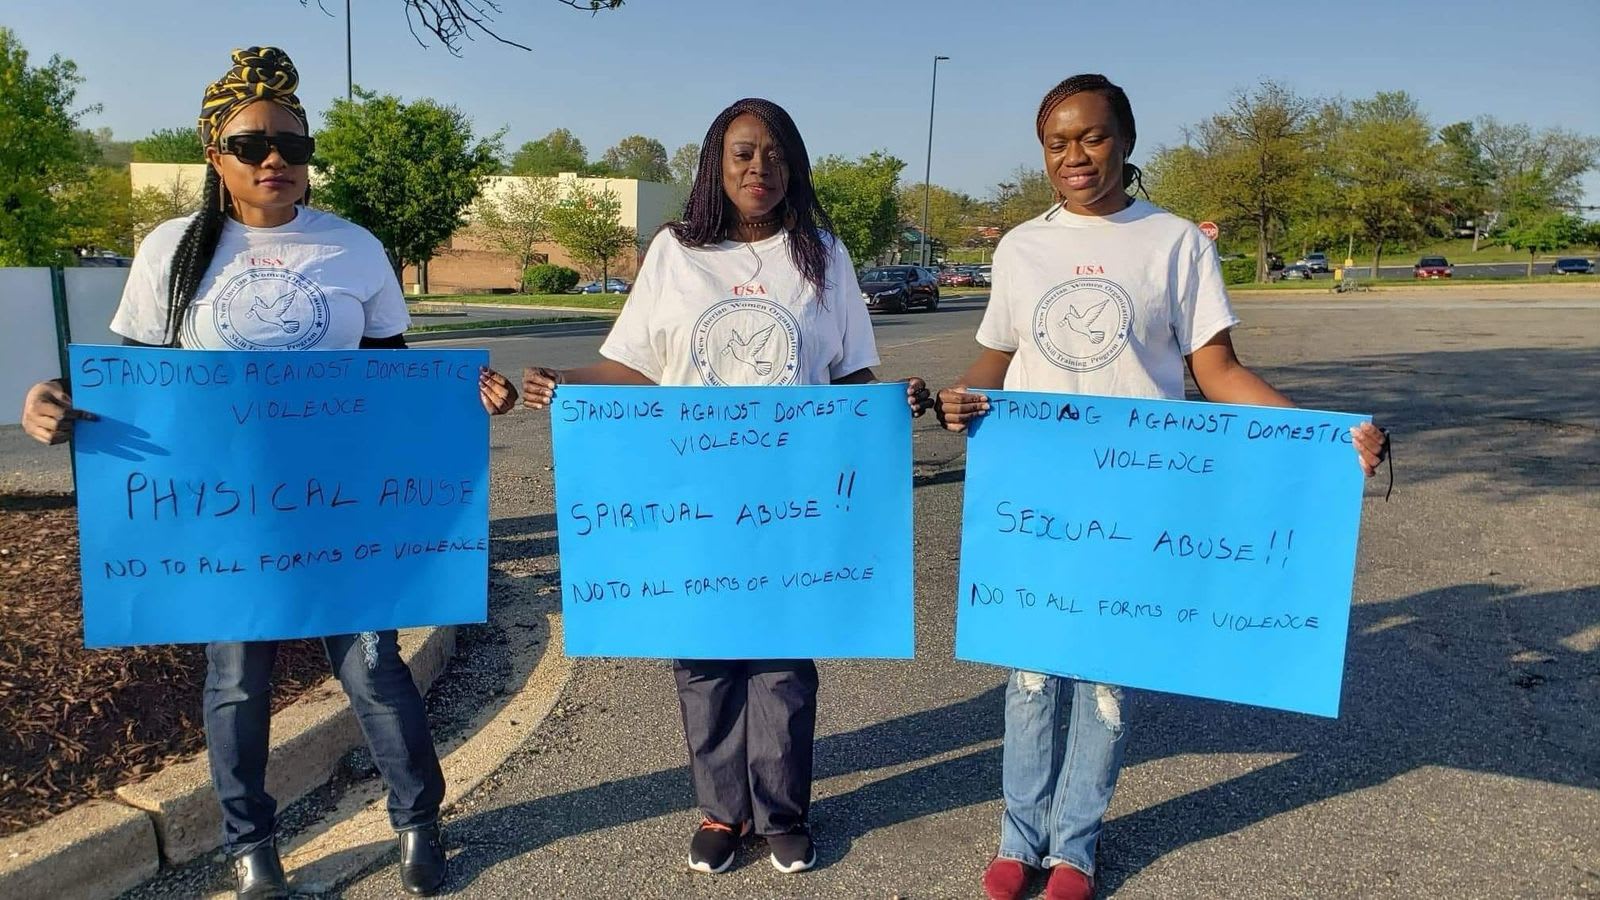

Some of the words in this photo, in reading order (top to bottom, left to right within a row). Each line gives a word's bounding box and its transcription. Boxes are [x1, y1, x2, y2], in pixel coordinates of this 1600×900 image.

[251, 258, 284, 266] USA
[1076, 265, 1105, 275] USA
[220, 303, 229, 319] New
[225, 278, 248, 302] Liberian
[250, 272, 286, 280] Women
[288, 275, 323, 319] Organization
[733, 284, 766, 296] USA
[700, 307, 728, 333] Liberian
[730, 302, 767, 311] Women
[1041, 288, 1068, 310] Liberian
[1105, 285, 1128, 330] Organization
[698, 337, 706, 355] New
[769, 307, 796, 360] Organization
[1045, 342, 1057, 359] Skill
[1057, 354, 1087, 367] Training
[1091, 344, 1119, 363] Program
[80, 357, 229, 388] STANDING
[245, 358, 353, 384] AGAINST
[366, 359, 469, 381] DOMESTIC
[232, 398, 367, 424] VIOLENCE
[562, 399, 664, 422] STANDING
[680, 401, 760, 421] AGAINST
[774, 398, 868, 423] DOMESTIC
[992, 399, 1101, 425] TANDING
[1129, 408, 1238, 435] AGAINST
[1247, 420, 1352, 444] DOMESTIC
[670, 429, 789, 456] VIOLENCE
[1094, 448, 1215, 474] VIOLENCE
[126, 472, 359, 520] PHYSICAL
[379, 478, 473, 507] ABUSE
[571, 502, 714, 536] SPIRITUAL
[996, 501, 1132, 541] SEXUAL
[104, 557, 147, 579] NO
[161, 558, 186, 575] TO
[200, 556, 246, 574] ALL
[260, 549, 343, 572] FORMS
[354, 543, 382, 560] OF
[394, 537, 488, 560] VIOLENCE
[641, 579, 674, 598] ALL
[684, 576, 740, 596] FORMS
[747, 576, 769, 591] OF
[782, 567, 874, 588] VIOLENCE
[971, 583, 1004, 606] NO
[1016, 588, 1036, 608] TO
[1046, 593, 1084, 613] ALL
[1098, 600, 1163, 618] FORMS
[1178, 608, 1200, 622] OF
[1213, 611, 1319, 631] VIOLENCE
